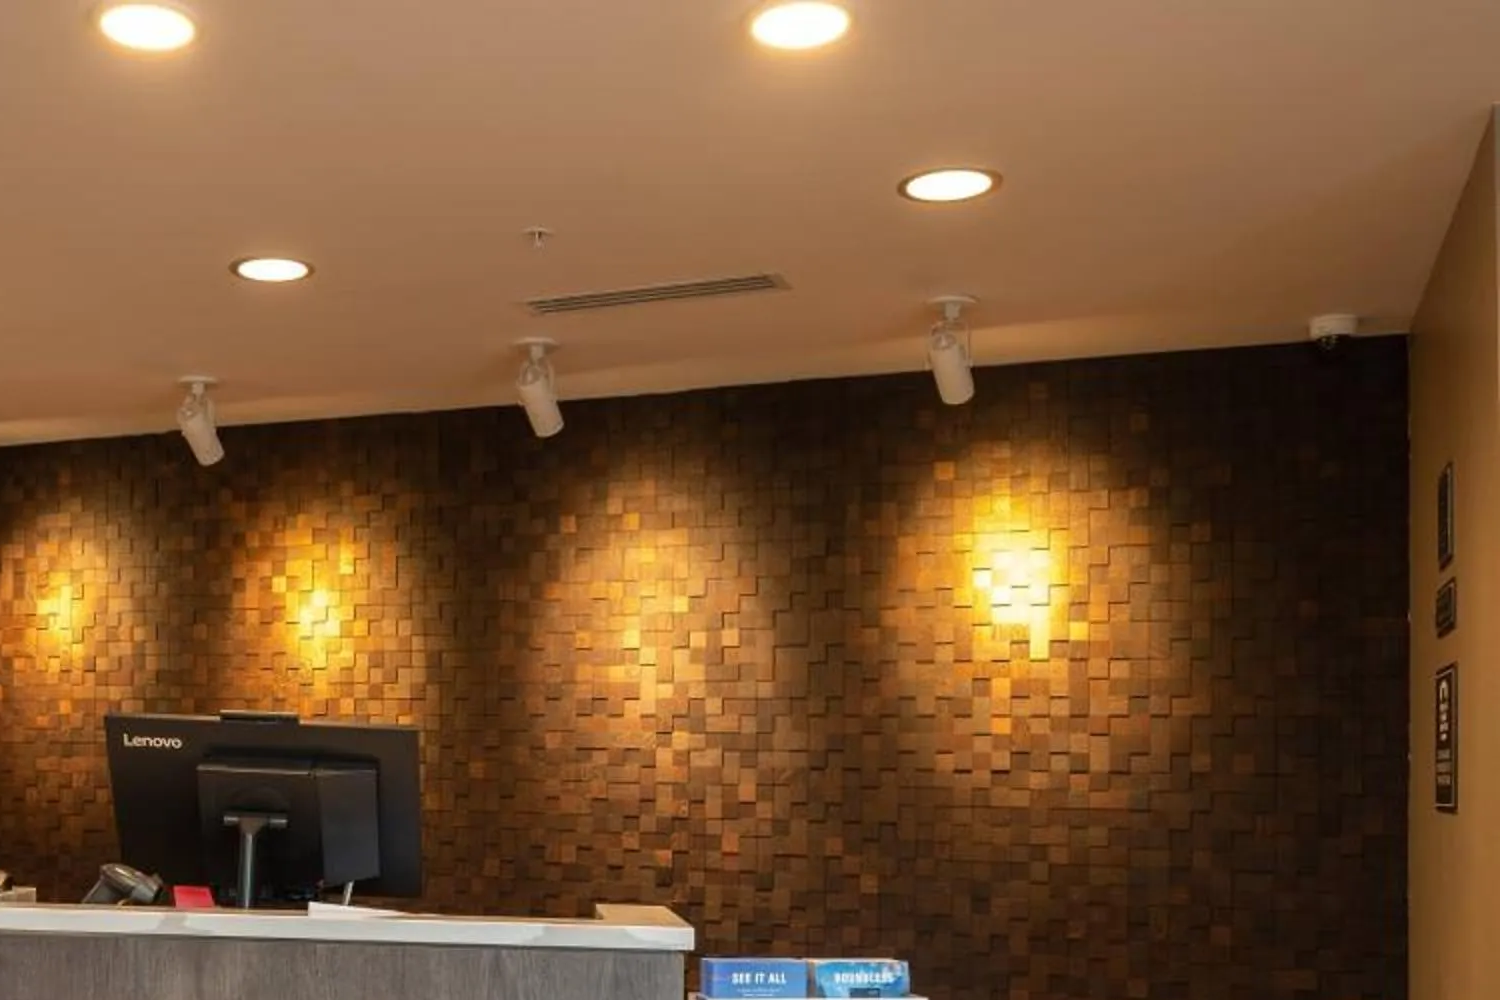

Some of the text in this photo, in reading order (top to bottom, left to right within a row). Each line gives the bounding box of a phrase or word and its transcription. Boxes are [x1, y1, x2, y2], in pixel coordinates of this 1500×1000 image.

[123, 733, 182, 749] Lenovo
[731, 971, 787, 985] SEE IT ALL
